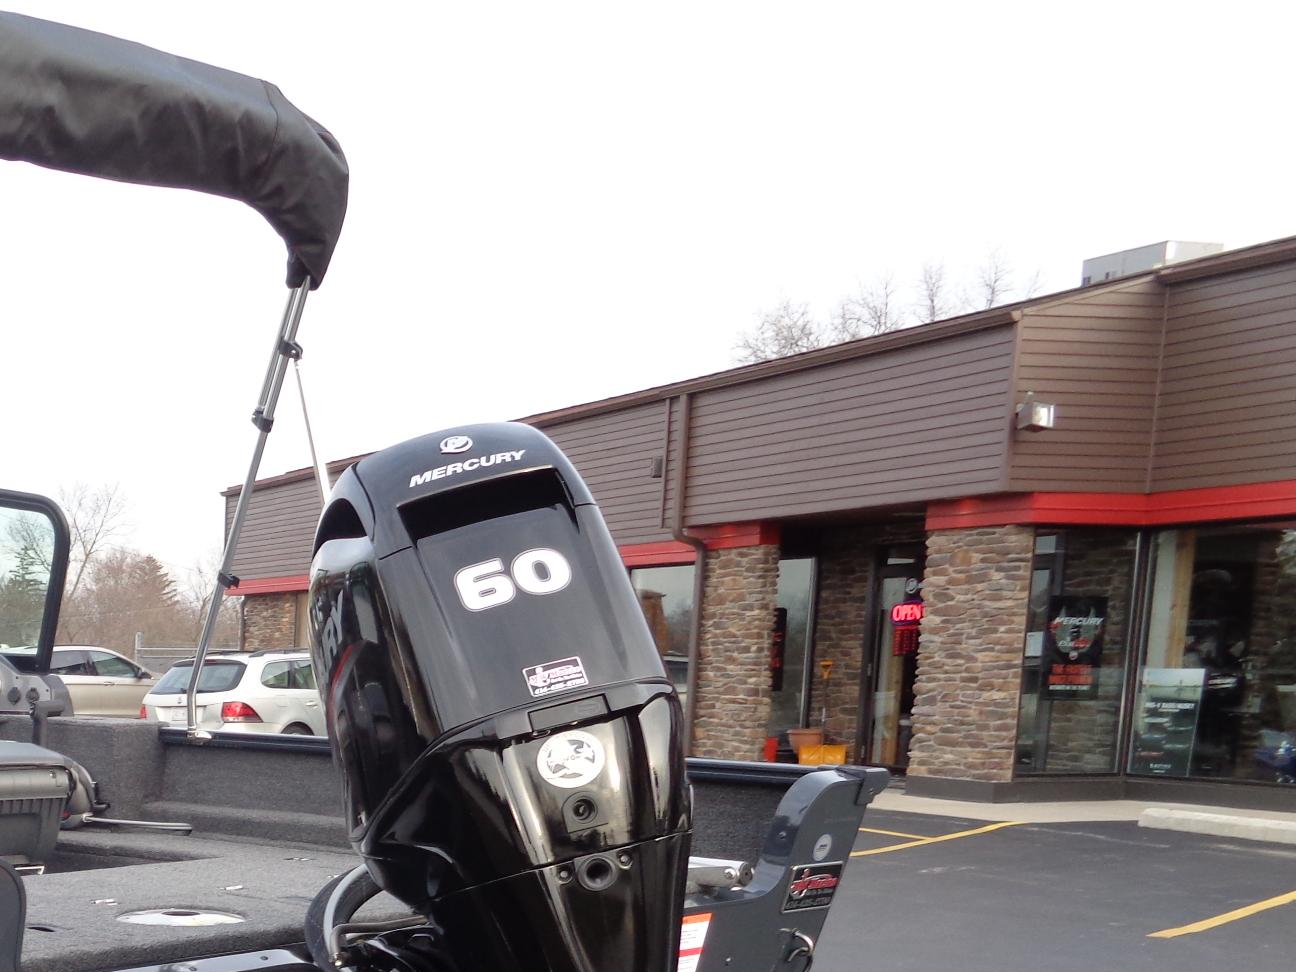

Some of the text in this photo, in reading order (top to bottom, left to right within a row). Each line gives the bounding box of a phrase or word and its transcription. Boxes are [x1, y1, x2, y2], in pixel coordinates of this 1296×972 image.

[409, 449, 526, 488] MERCURY
[454, 548, 572, 613] 60
[892, 603, 921, 621] OPEN
[1054, 616, 1104, 626] MERCURY
